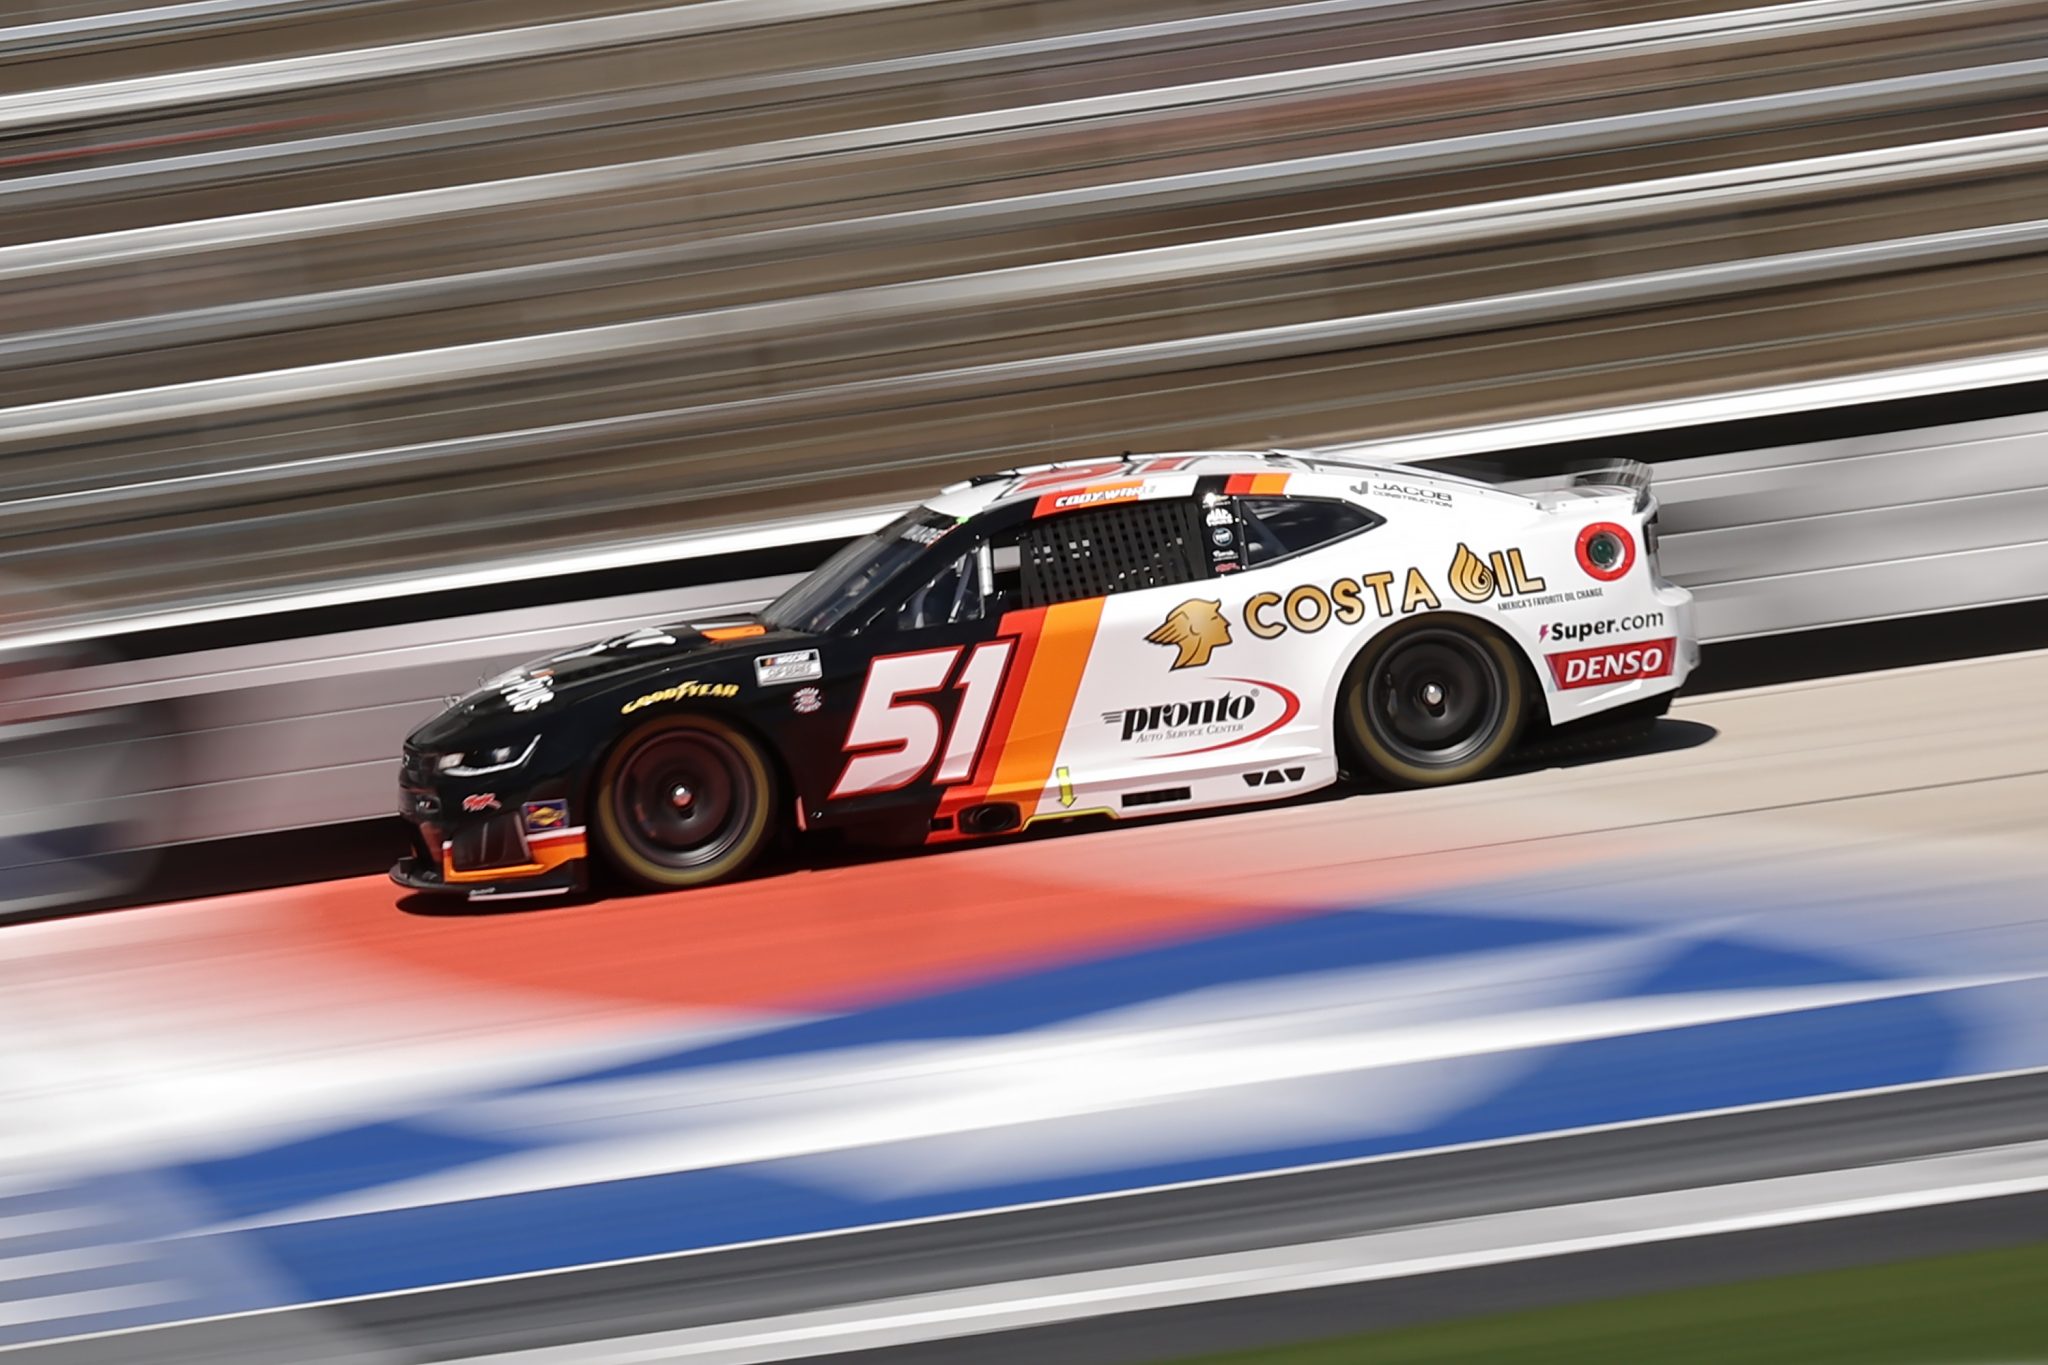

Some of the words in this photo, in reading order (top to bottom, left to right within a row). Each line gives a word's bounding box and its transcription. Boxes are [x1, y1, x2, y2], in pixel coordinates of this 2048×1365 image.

[1055, 489, 1104, 508] CODY
[1373, 483, 1453, 502] JACOB
[1243, 566, 1441, 639] COSTA
[1497, 598, 1532, 611] AMERICA'S
[1532, 593, 1564, 607] FAVORITE
[1576, 587, 1604, 600] CHANGE
[1551, 612, 1664, 642] Super.com
[1565, 648, 1663, 683] DENSO
[621, 680, 740, 714] GOODYEAR
[827, 637, 1018, 800] 51
[1121, 692, 1256, 742] pronto
[1166, 728, 1203, 740] SERVICE
[1206, 723, 1245, 736] CENTER
